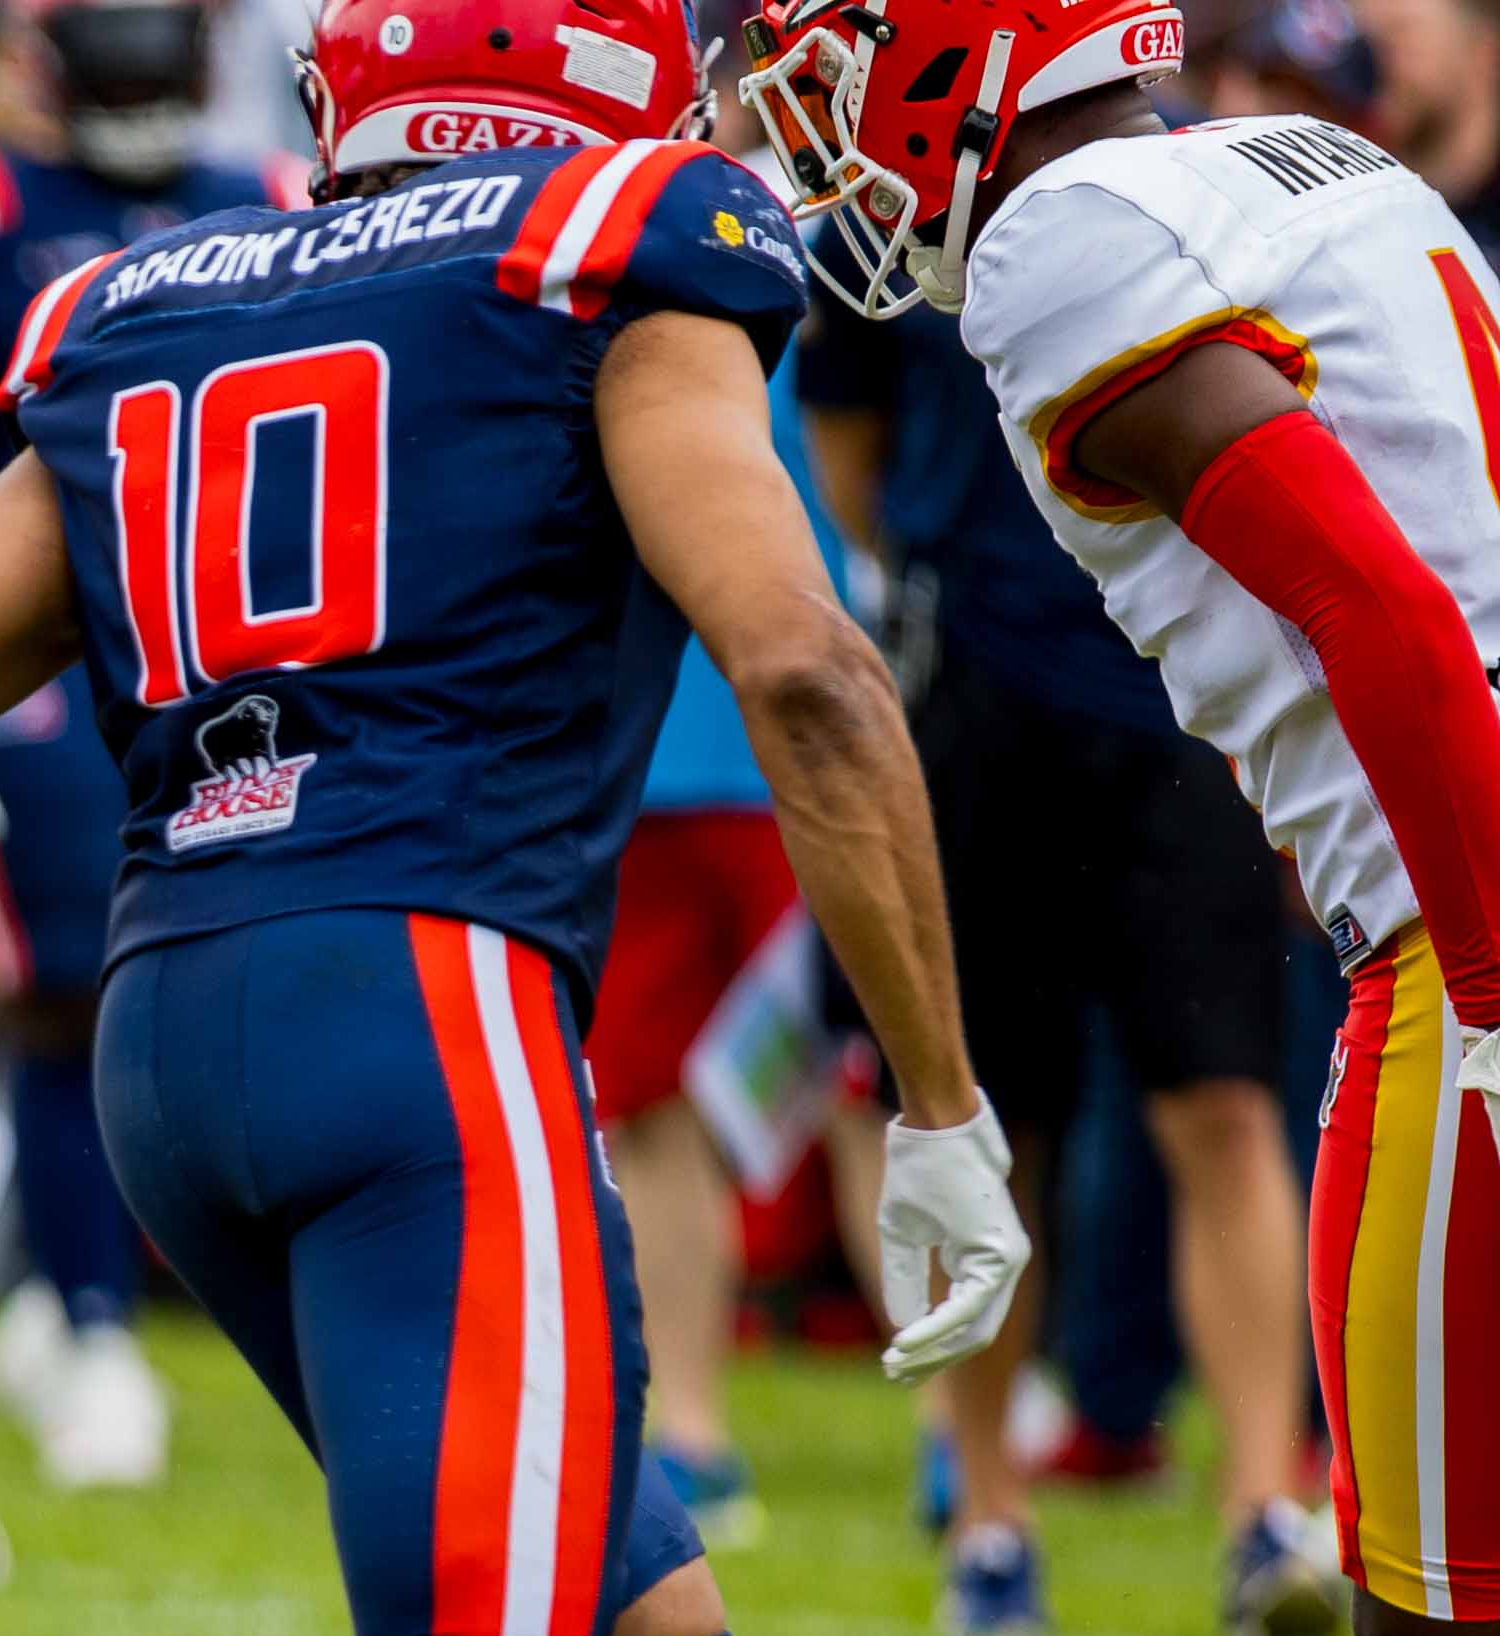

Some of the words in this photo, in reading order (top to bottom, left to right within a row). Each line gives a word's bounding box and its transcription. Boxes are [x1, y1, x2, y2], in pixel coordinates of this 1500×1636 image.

[387, 24, 406, 46] 10
[420, 113, 572, 152] GAZI
[108, 339, 391, 709] 10
